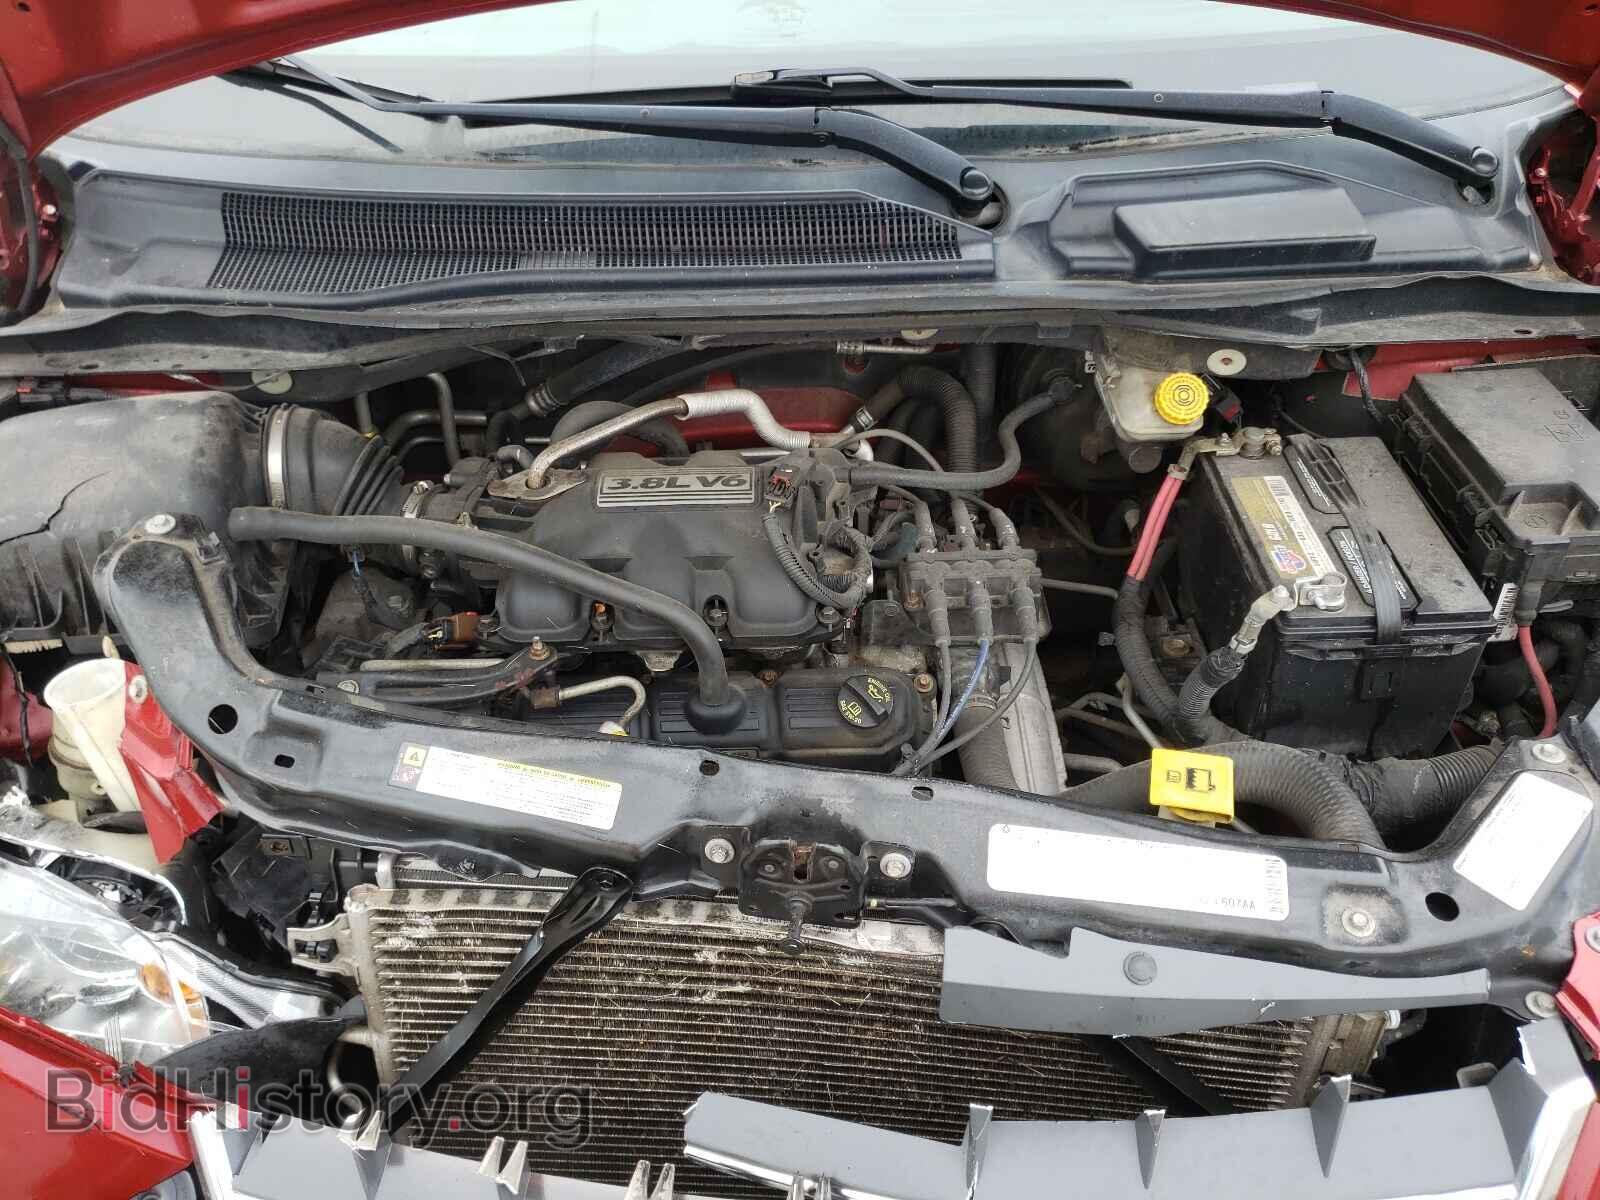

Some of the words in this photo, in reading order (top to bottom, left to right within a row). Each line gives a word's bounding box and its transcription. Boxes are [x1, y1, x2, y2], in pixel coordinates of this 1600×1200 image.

[607, 476, 690, 490] 3.8L
[696, 474, 747, 488] V6
[867, 677, 888, 693] ENGINE
[840, 700, 848, 712] SAE
